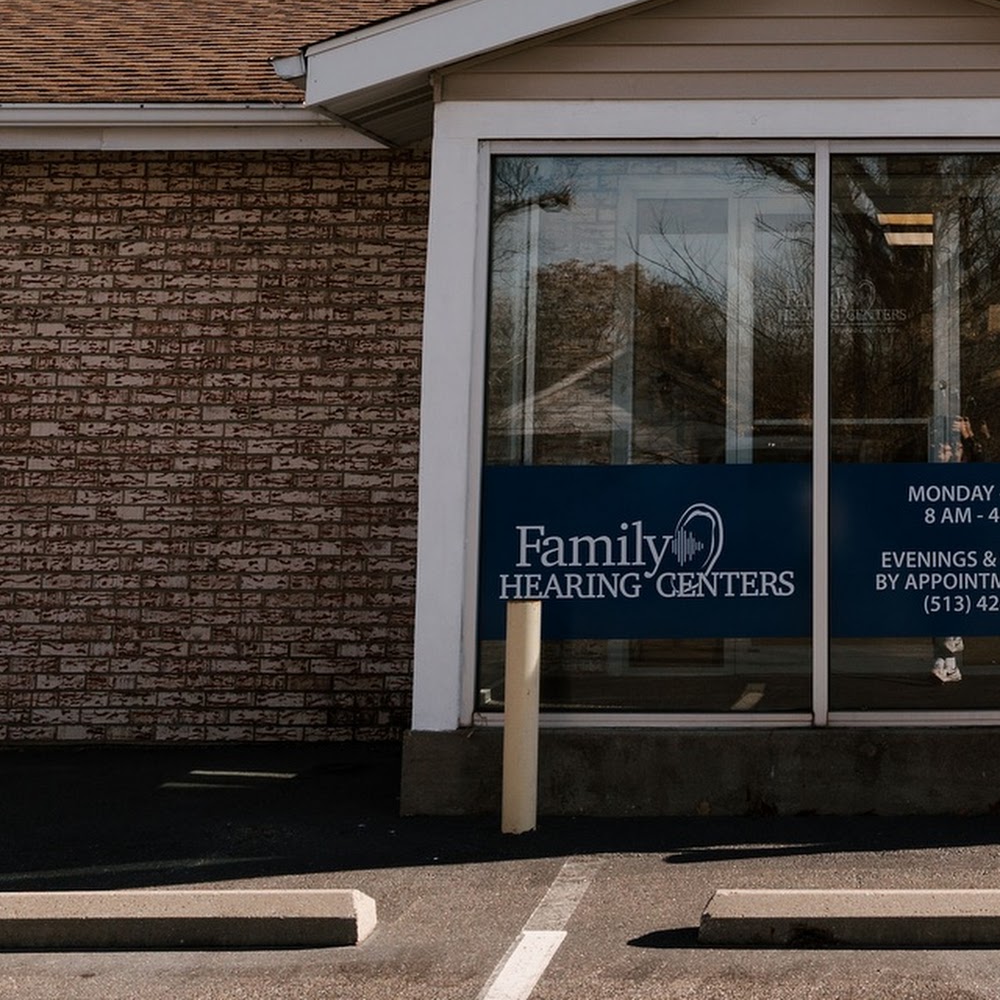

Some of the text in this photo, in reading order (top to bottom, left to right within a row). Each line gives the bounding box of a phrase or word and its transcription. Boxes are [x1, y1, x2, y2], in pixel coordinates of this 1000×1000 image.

[847, 308, 907, 321] CENTERS
[908, 485, 994, 502] MONDAY
[924, 508, 935, 524] 8
[941, 507, 972, 523] AM
[516, 520, 673, 578] Family
[881, 551, 977, 568] EVENINGS
[983, 551, 997, 567] &
[500, 571, 795, 599] HEARING CENTERS
[876, 574, 899, 590] BY
[924, 595, 971, 614] (513)
